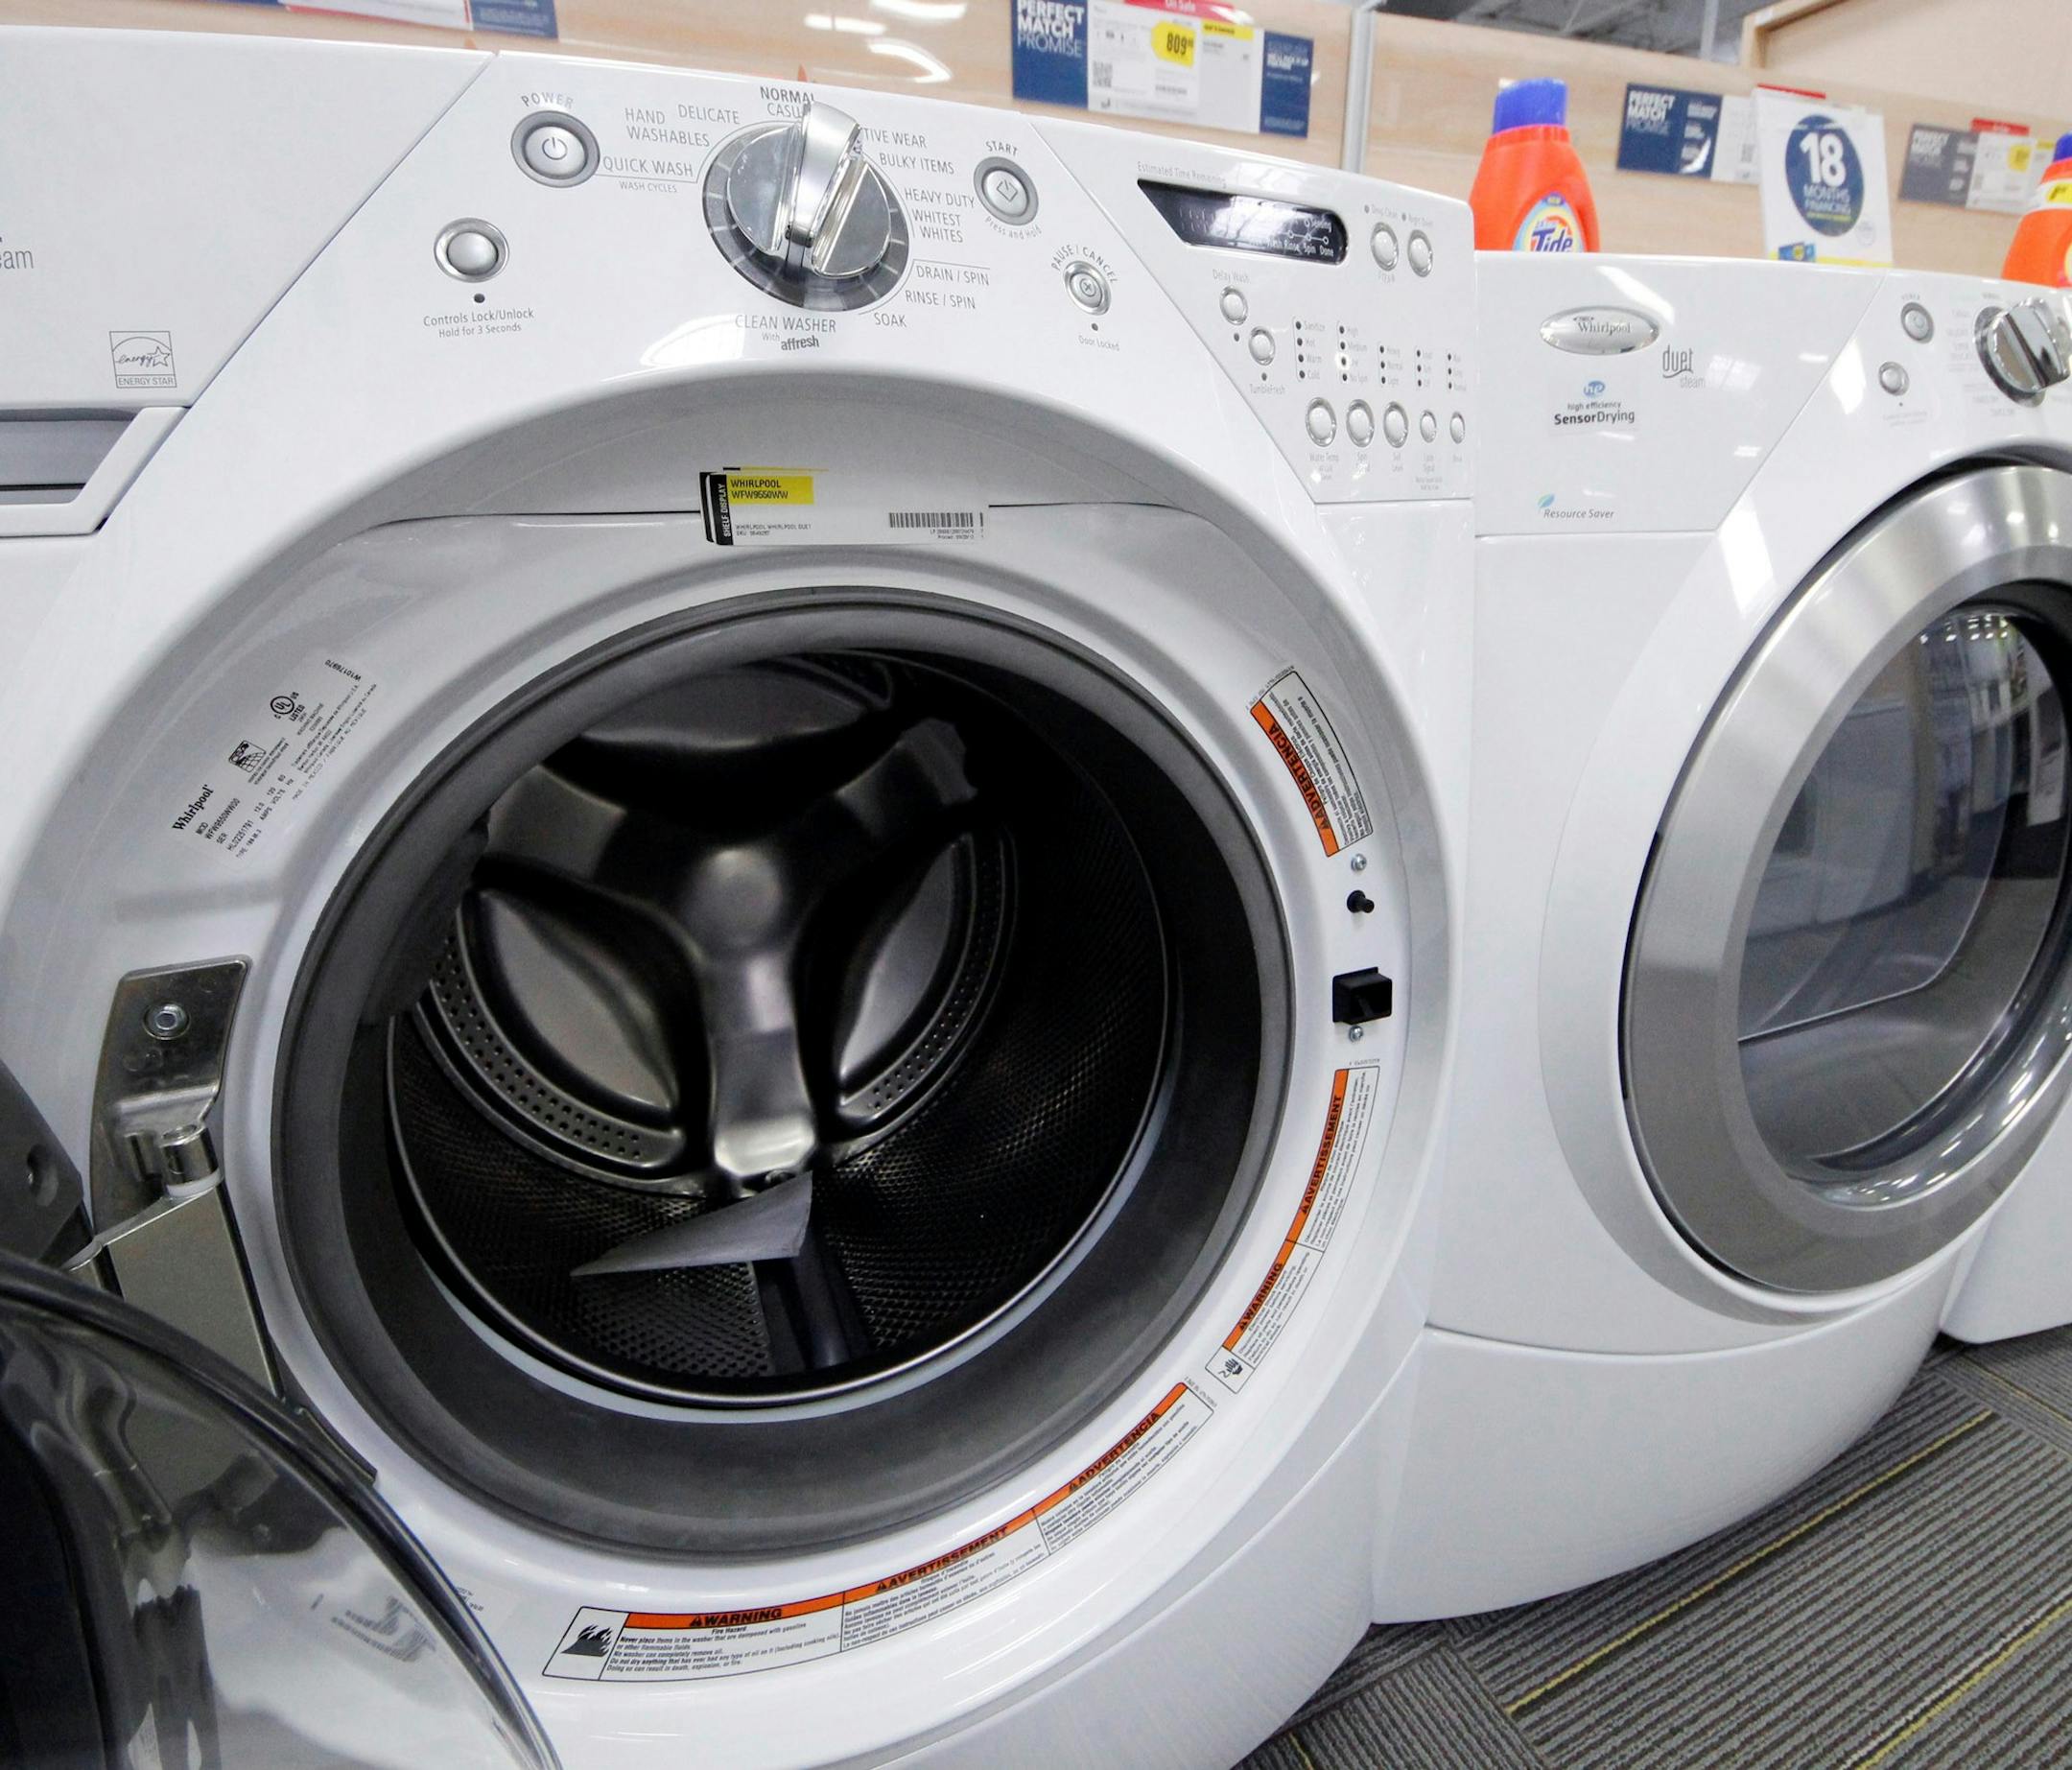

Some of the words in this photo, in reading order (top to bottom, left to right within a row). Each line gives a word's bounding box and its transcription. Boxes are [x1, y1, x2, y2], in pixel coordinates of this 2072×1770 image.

[1017, 0, 1085, 25] PERFECT
[1017, 14, 1073, 38] MATCH
[1018, 31, 1083, 58] PROMISE
[521, 91, 574, 108] POWER
[1629, 90, 1676, 109] PERFECT
[624, 107, 665, 125] HAND
[677, 104, 741, 124] DELICATE
[766, 103, 802, 118] CASU
[626, 126, 710, 147] WASHABLES
[859, 127, 888, 143] TIVE
[891, 131, 927, 148] WEAR
[985, 141, 1018, 156] START
[603, 155, 648, 174] QUICK
[651, 160, 694, 177] WASH
[880, 153, 918, 169] BULKY
[921, 158, 955, 175] ITEMS
[1137, 161, 1173, 177] Estimated
[1800, 131, 1847, 187] 18
[619, 180, 646, 192] WASH
[648, 182, 677, 193] CYCLES
[905, 188, 942, 203] HEAVY
[945, 192, 976, 209] DUTY
[912, 209, 961, 226] WHITEST
[919, 225, 964, 244] WHITES
[1531, 227, 1573, 252] Tide
[0, 249, 34, 270] am
[1051, 245, 1073, 271] PAUSE
[1082, 247, 1118, 283] CANCEL
[916, 265, 953, 282] DRAIN
[963, 271, 990, 286] SPIN
[1213, 269, 1232, 283] Delay
[905, 291, 938, 306] RINSE
[950, 295, 976, 309] SPIN
[423, 312, 468, 327] Controls
[471, 307, 534, 323] Lock/Unlock
[735, 314, 778, 329] CLEAN
[782, 317, 836, 333] WASHER
[874, 312, 906, 327] SOAK
[438, 326, 459, 338] Hold
[461, 325, 475, 336] for
[478, 324, 483, 334] 3
[486, 322, 522, 334] Seconds
[1578, 321, 1631, 336] Whirlpool
[781, 335, 819, 351] affresh
[1662, 343, 1693, 373] duet
[118, 377, 151, 386] ENERGY
[153, 377, 174, 386] STAR
[1680, 376, 1706, 389] steam
[1567, 401, 1584, 412] high
[1586, 399, 1621, 411] efficiency
[1554, 410, 1635, 425] SensorDrying
[731, 480, 781, 488] WHIRLPOOL
[718, 484, 729, 512] DISPLAY
[1543, 508, 1587, 519] Resource
[1589, 508, 1614, 519] Saver
[719, 515, 731, 537] SHELF
[1268, 722, 1325, 821] ADVERTENCIA
[173, 784, 214, 831] Whirlpool
[1306, 1096, 1341, 1203] AVERTISSEMENT
[1243, 1263, 1283, 1322] WARNING
[1077, 1411, 1161, 1486] ADVERTENCIA
[888, 1526, 1007, 1589] AVERTISSEMENT
[704, 1608, 782, 1626] WARNING
